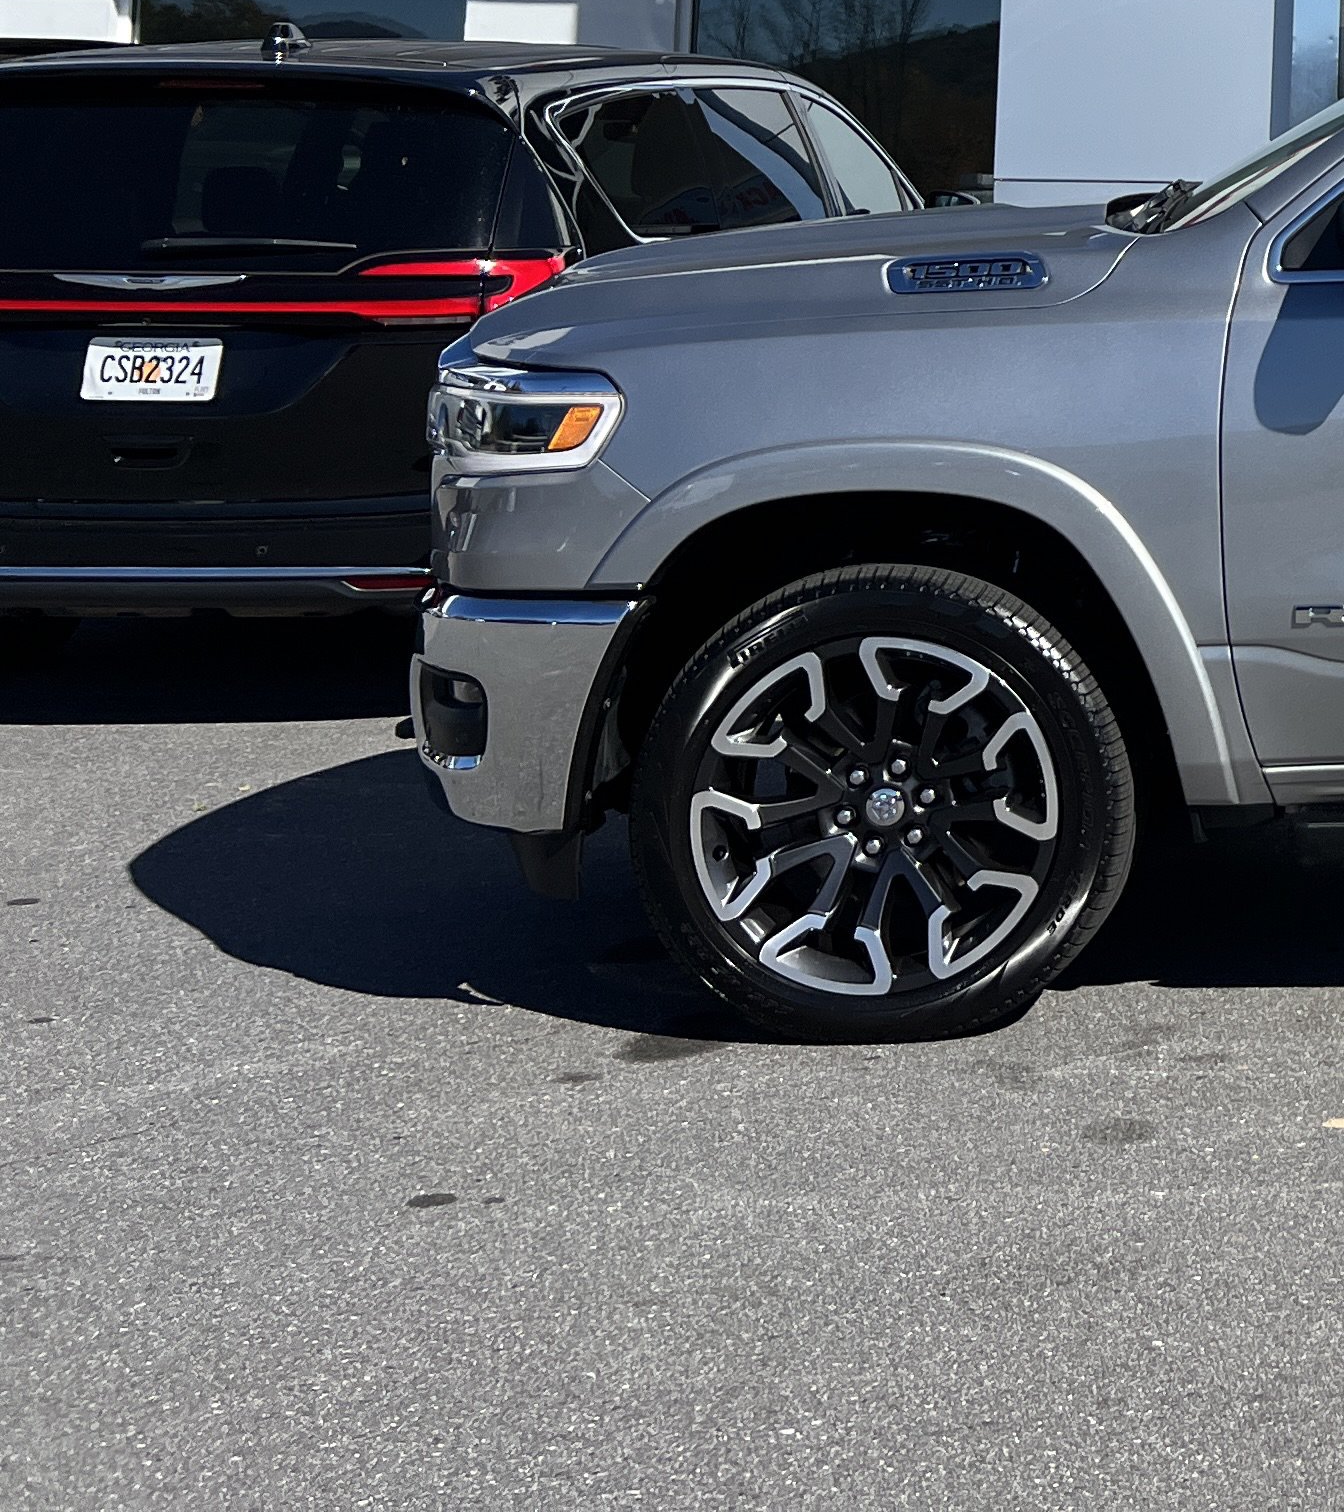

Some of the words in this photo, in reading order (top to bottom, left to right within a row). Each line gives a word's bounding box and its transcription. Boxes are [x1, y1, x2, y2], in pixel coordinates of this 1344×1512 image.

[909, 261, 1024, 278] 1500
[120, 341, 190, 353] GEORGIA
[100, 354, 204, 384] CSB2324
